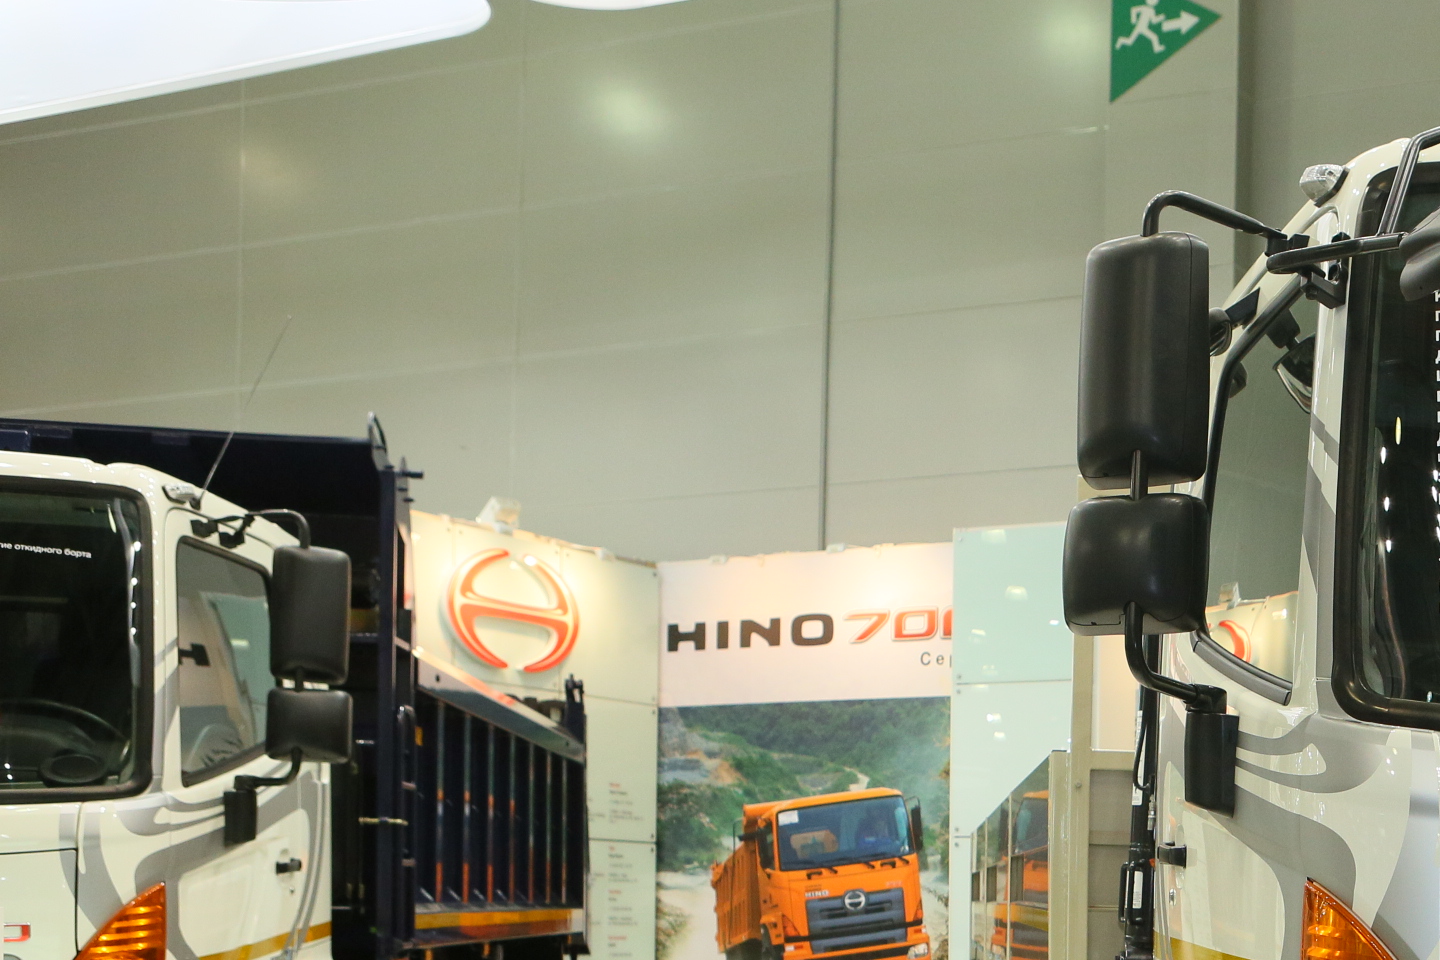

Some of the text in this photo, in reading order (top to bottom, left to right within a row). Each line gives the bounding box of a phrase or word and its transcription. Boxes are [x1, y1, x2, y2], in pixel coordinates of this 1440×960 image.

[14, 544, 62, 555] откидного
[64, 548, 92, 558] борта
[667, 613, 834, 652] HINO
